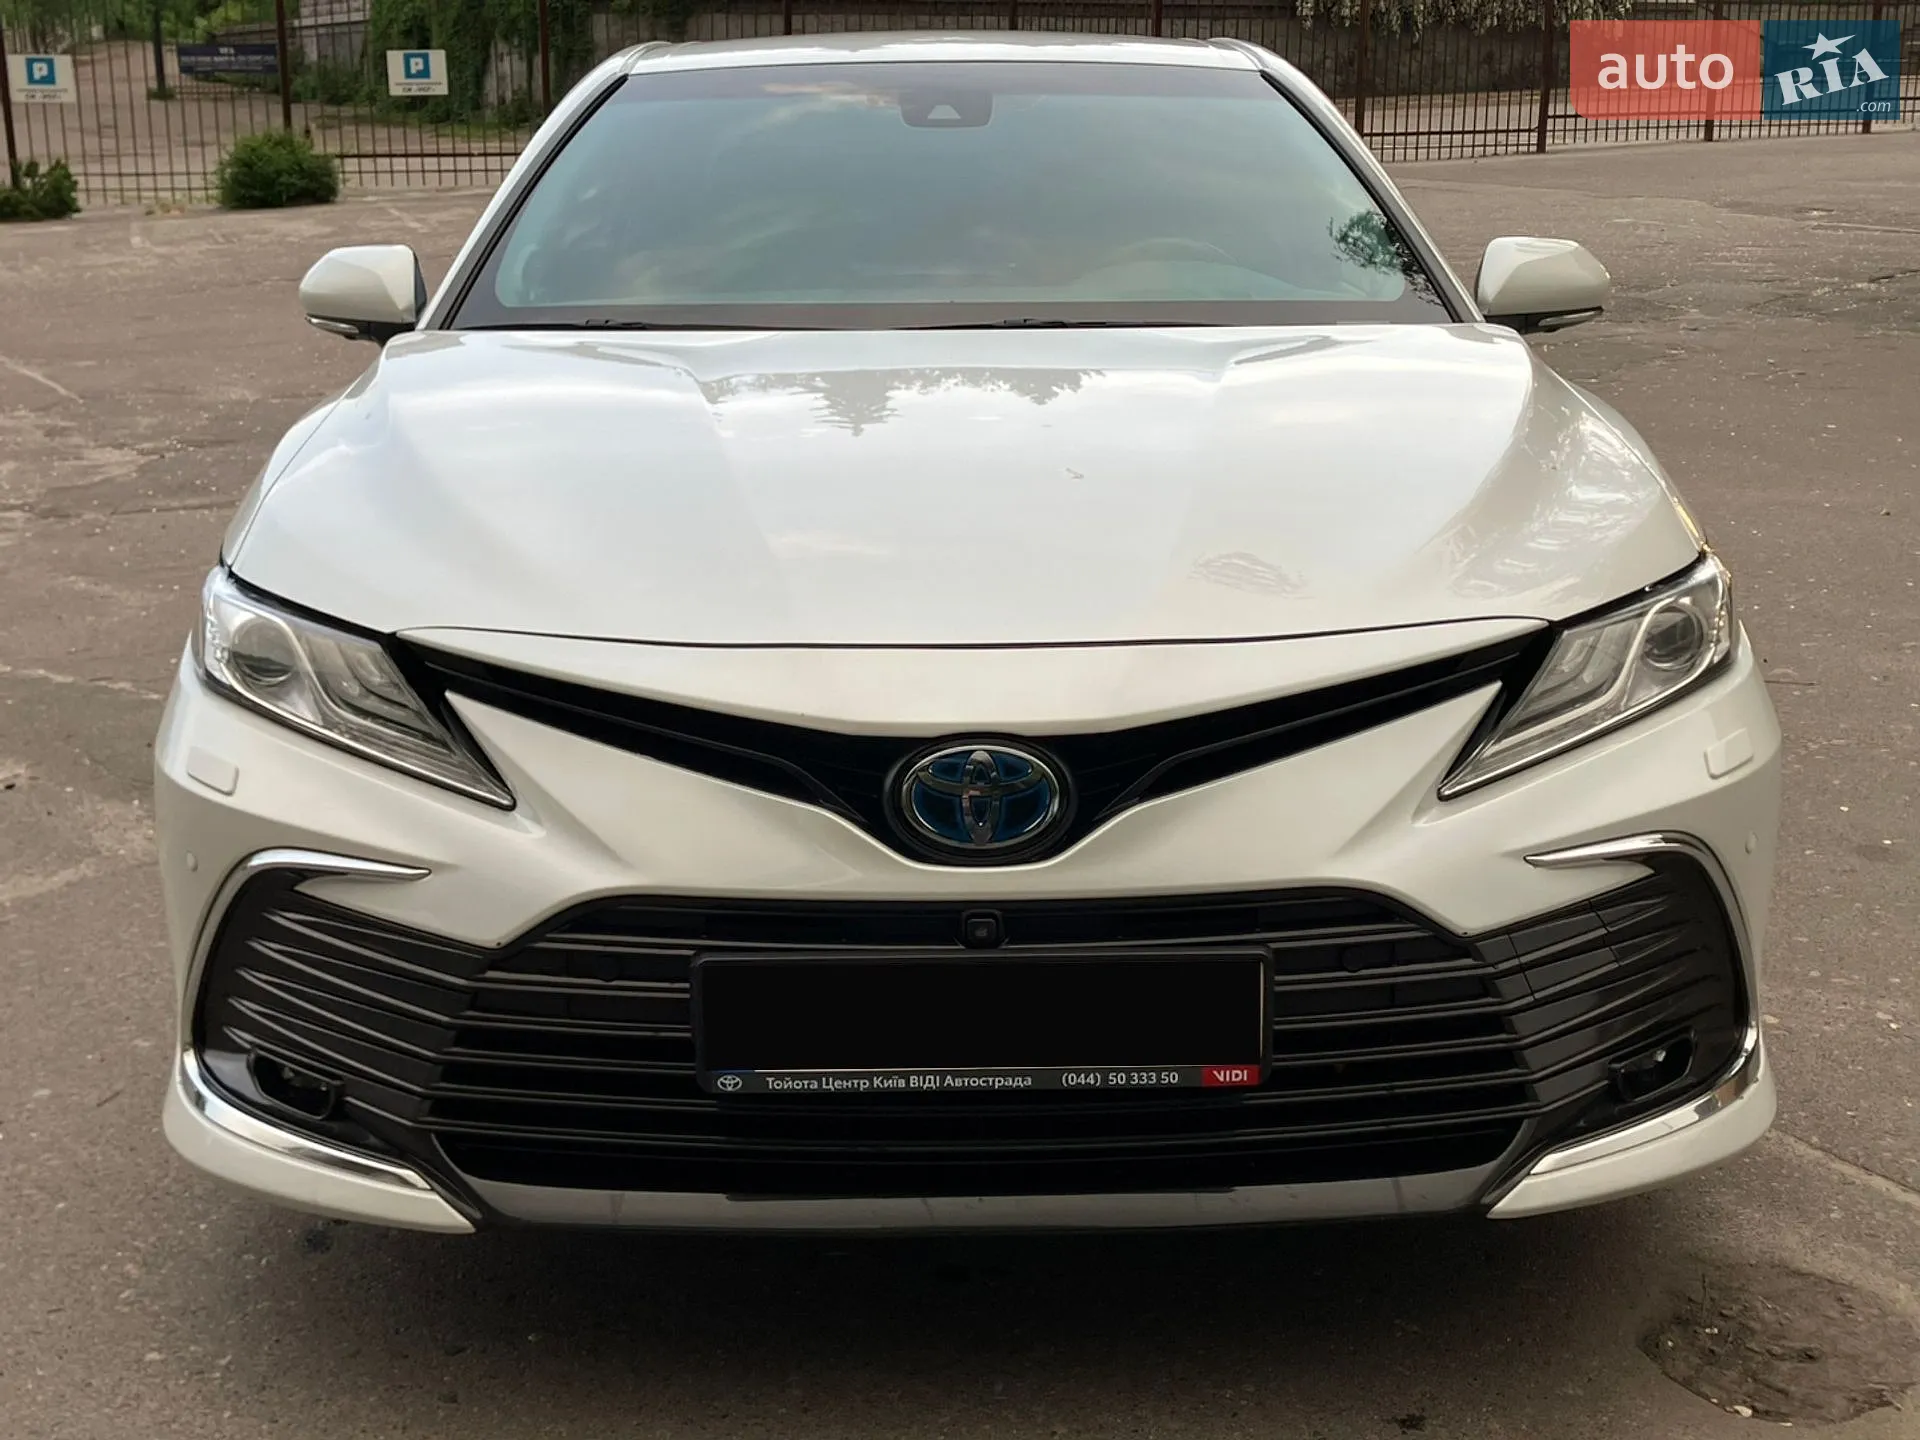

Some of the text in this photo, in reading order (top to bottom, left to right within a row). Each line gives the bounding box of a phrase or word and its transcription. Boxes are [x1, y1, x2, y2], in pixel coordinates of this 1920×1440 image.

[32, 62, 49, 80] P
[408, 57, 424, 74] P
[766, 1071, 1179, 1092] Тойота Центр Київ ВІДІ Автострада (044) 50 333 50
[1212, 1069, 1248, 1083] VIDI
